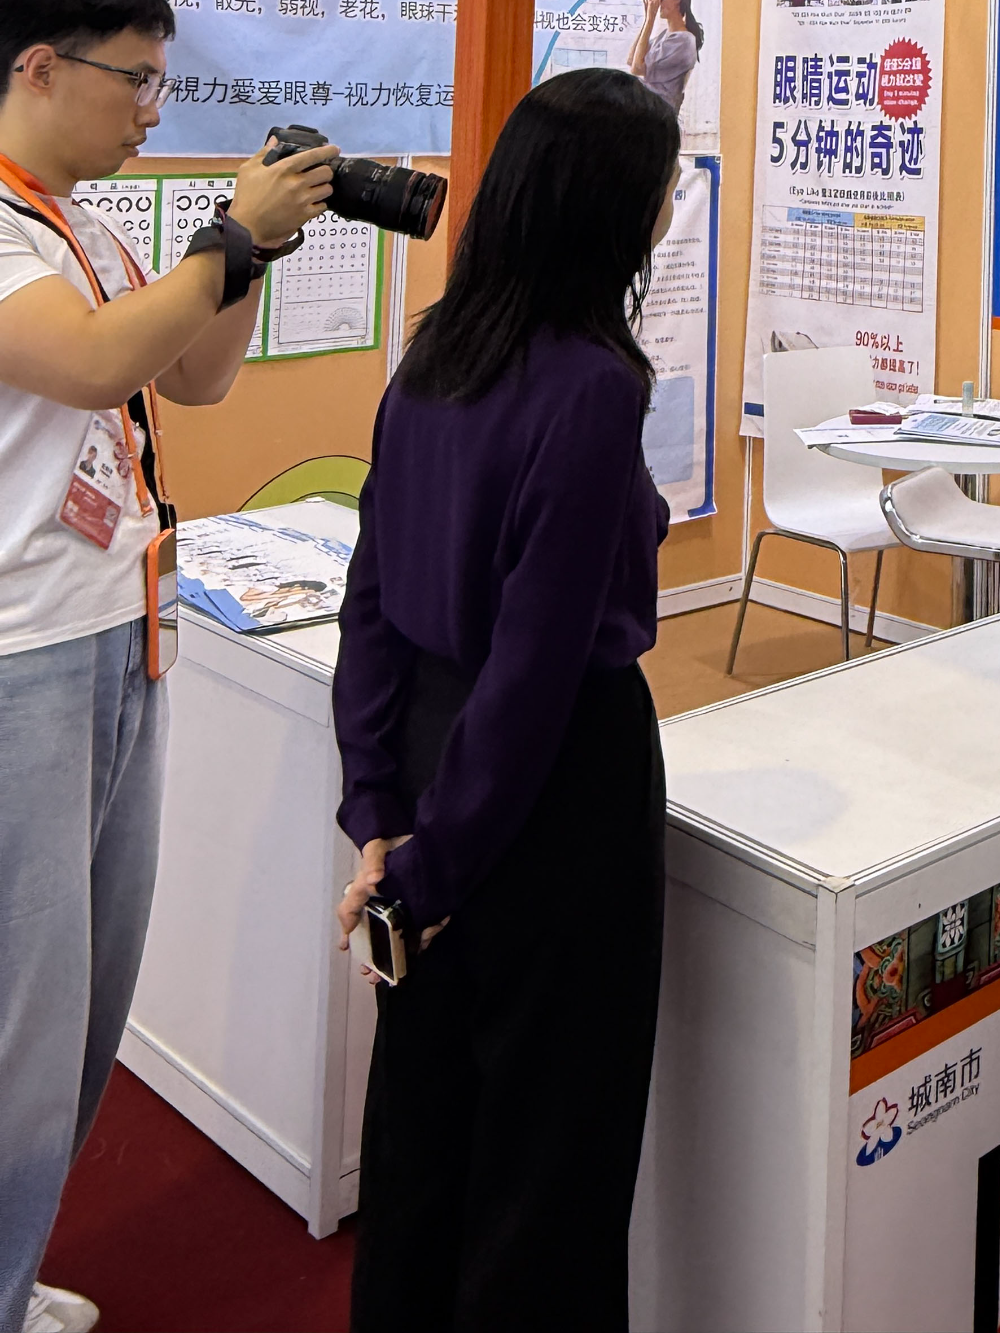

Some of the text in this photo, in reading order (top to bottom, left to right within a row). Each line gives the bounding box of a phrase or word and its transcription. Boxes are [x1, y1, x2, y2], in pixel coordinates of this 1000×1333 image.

[772, 52, 879, 109] 眼睛运动
[770, 119, 925, 177] 5分钟的奇迹
[855, 330, 904, 353] 90%以上
[907, 1047, 983, 1117] 城南市
